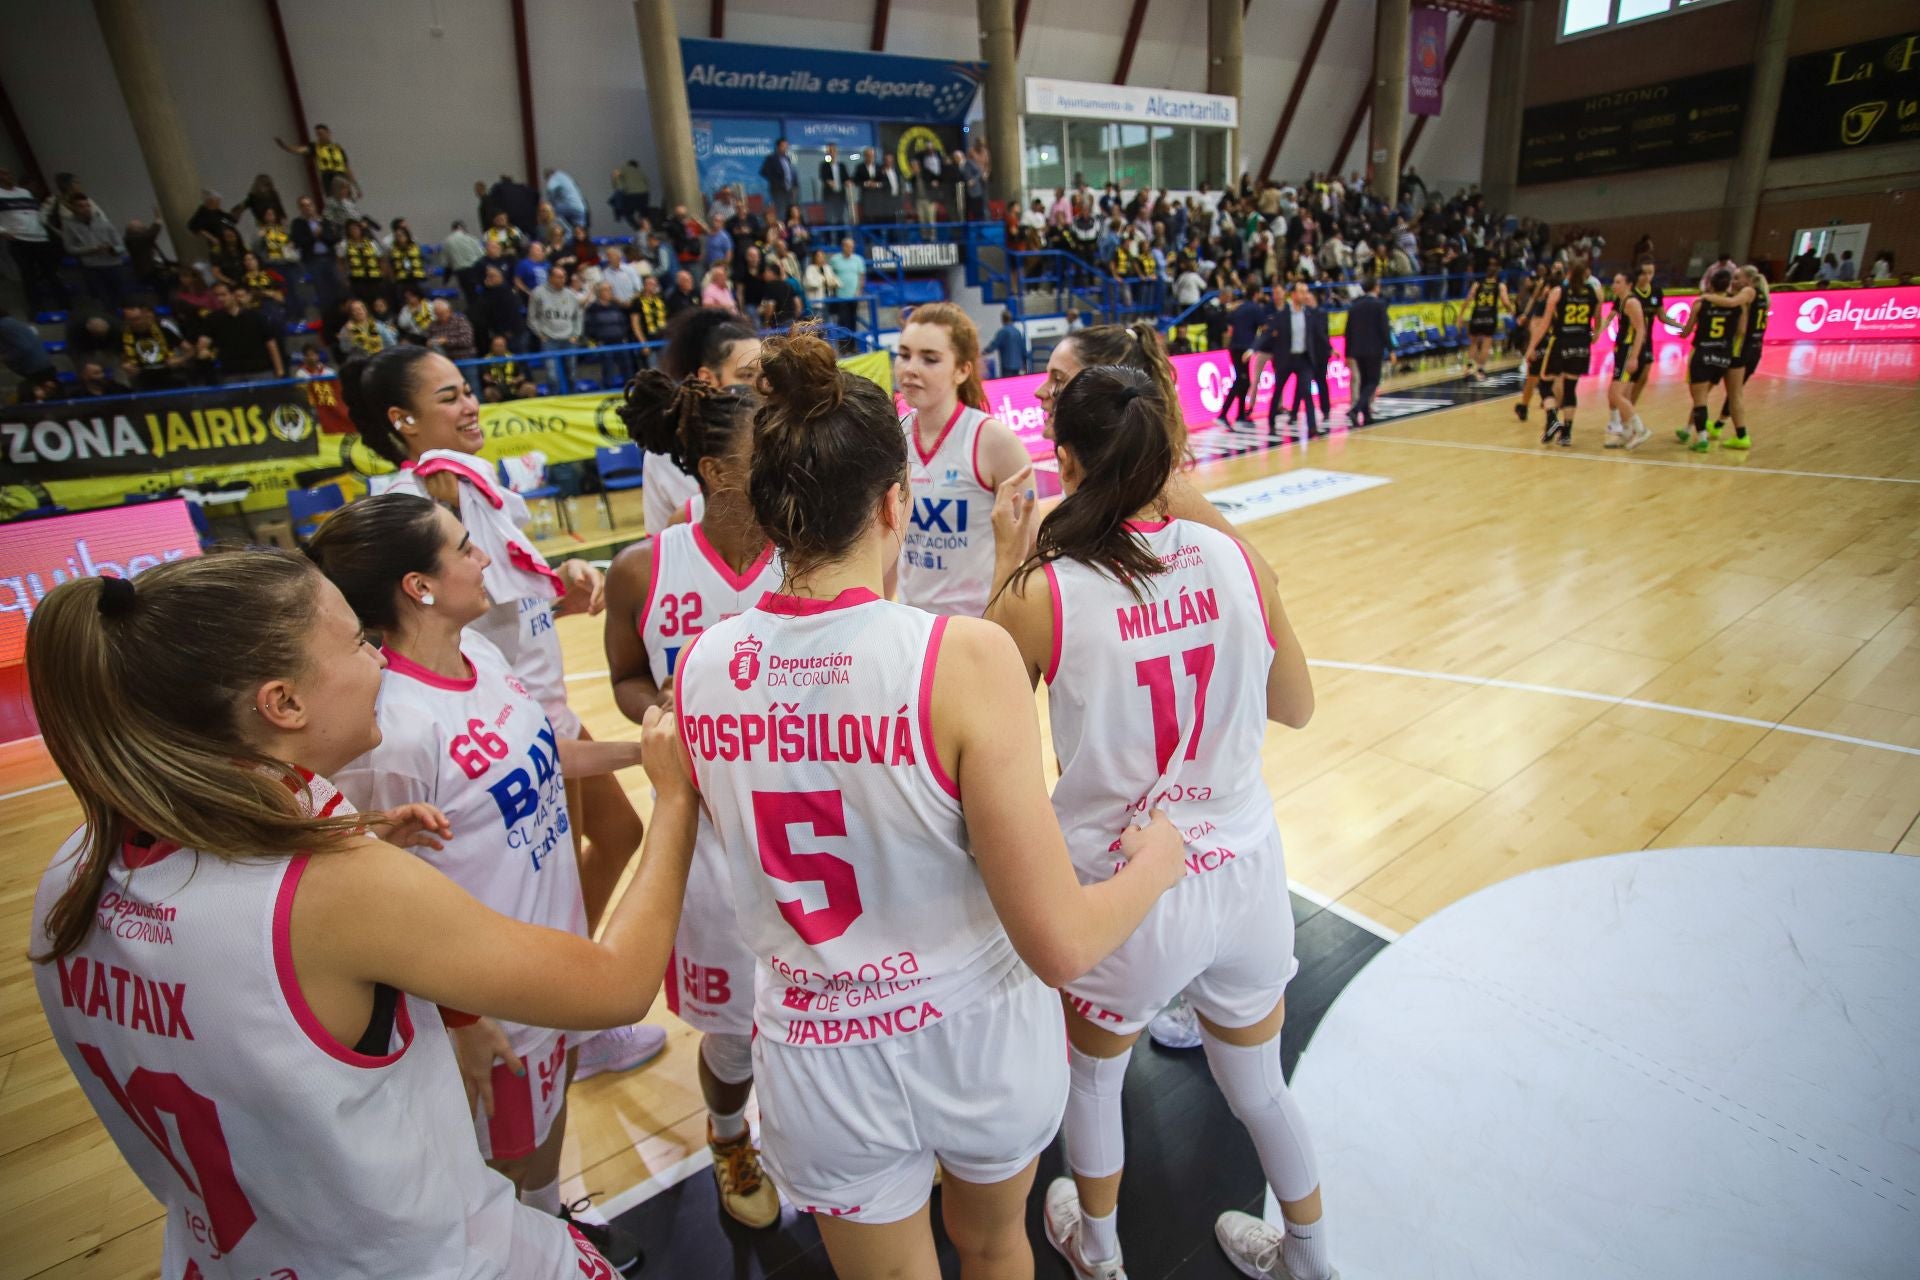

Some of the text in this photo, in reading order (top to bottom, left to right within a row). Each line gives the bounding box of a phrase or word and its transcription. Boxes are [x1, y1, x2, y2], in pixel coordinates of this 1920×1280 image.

[688, 63, 936, 99] Alcantarilla es deporte
[1824, 51, 1874, 86] La
[1145, 95, 1232, 122] Alcantarilla
[871, 243, 959, 267] ALANTARILLA
[1564, 303, 1590, 324] 22
[1709, 316, 1726, 338] 5
[485, 415, 568, 438] ZONO
[994, 394, 1045, 431] iber
[1, 404, 267, 464] ZONA JAIRIS
[659, 591, 704, 637] 32
[1116, 585, 1220, 642] MILLÁN
[767, 667, 850, 688] DA CORUÑA
[769, 651, 853, 673] Deputación
[1135, 643, 1216, 775] 17
[449, 718, 509, 780] 66
[684, 701, 917, 767] POSPÍŠILOVÁ
[751, 788, 864, 946] 5
[116, 919, 174, 945] CORUÑA
[56, 954, 194, 1041] MATAIX
[816, 993, 840, 1013] DE
